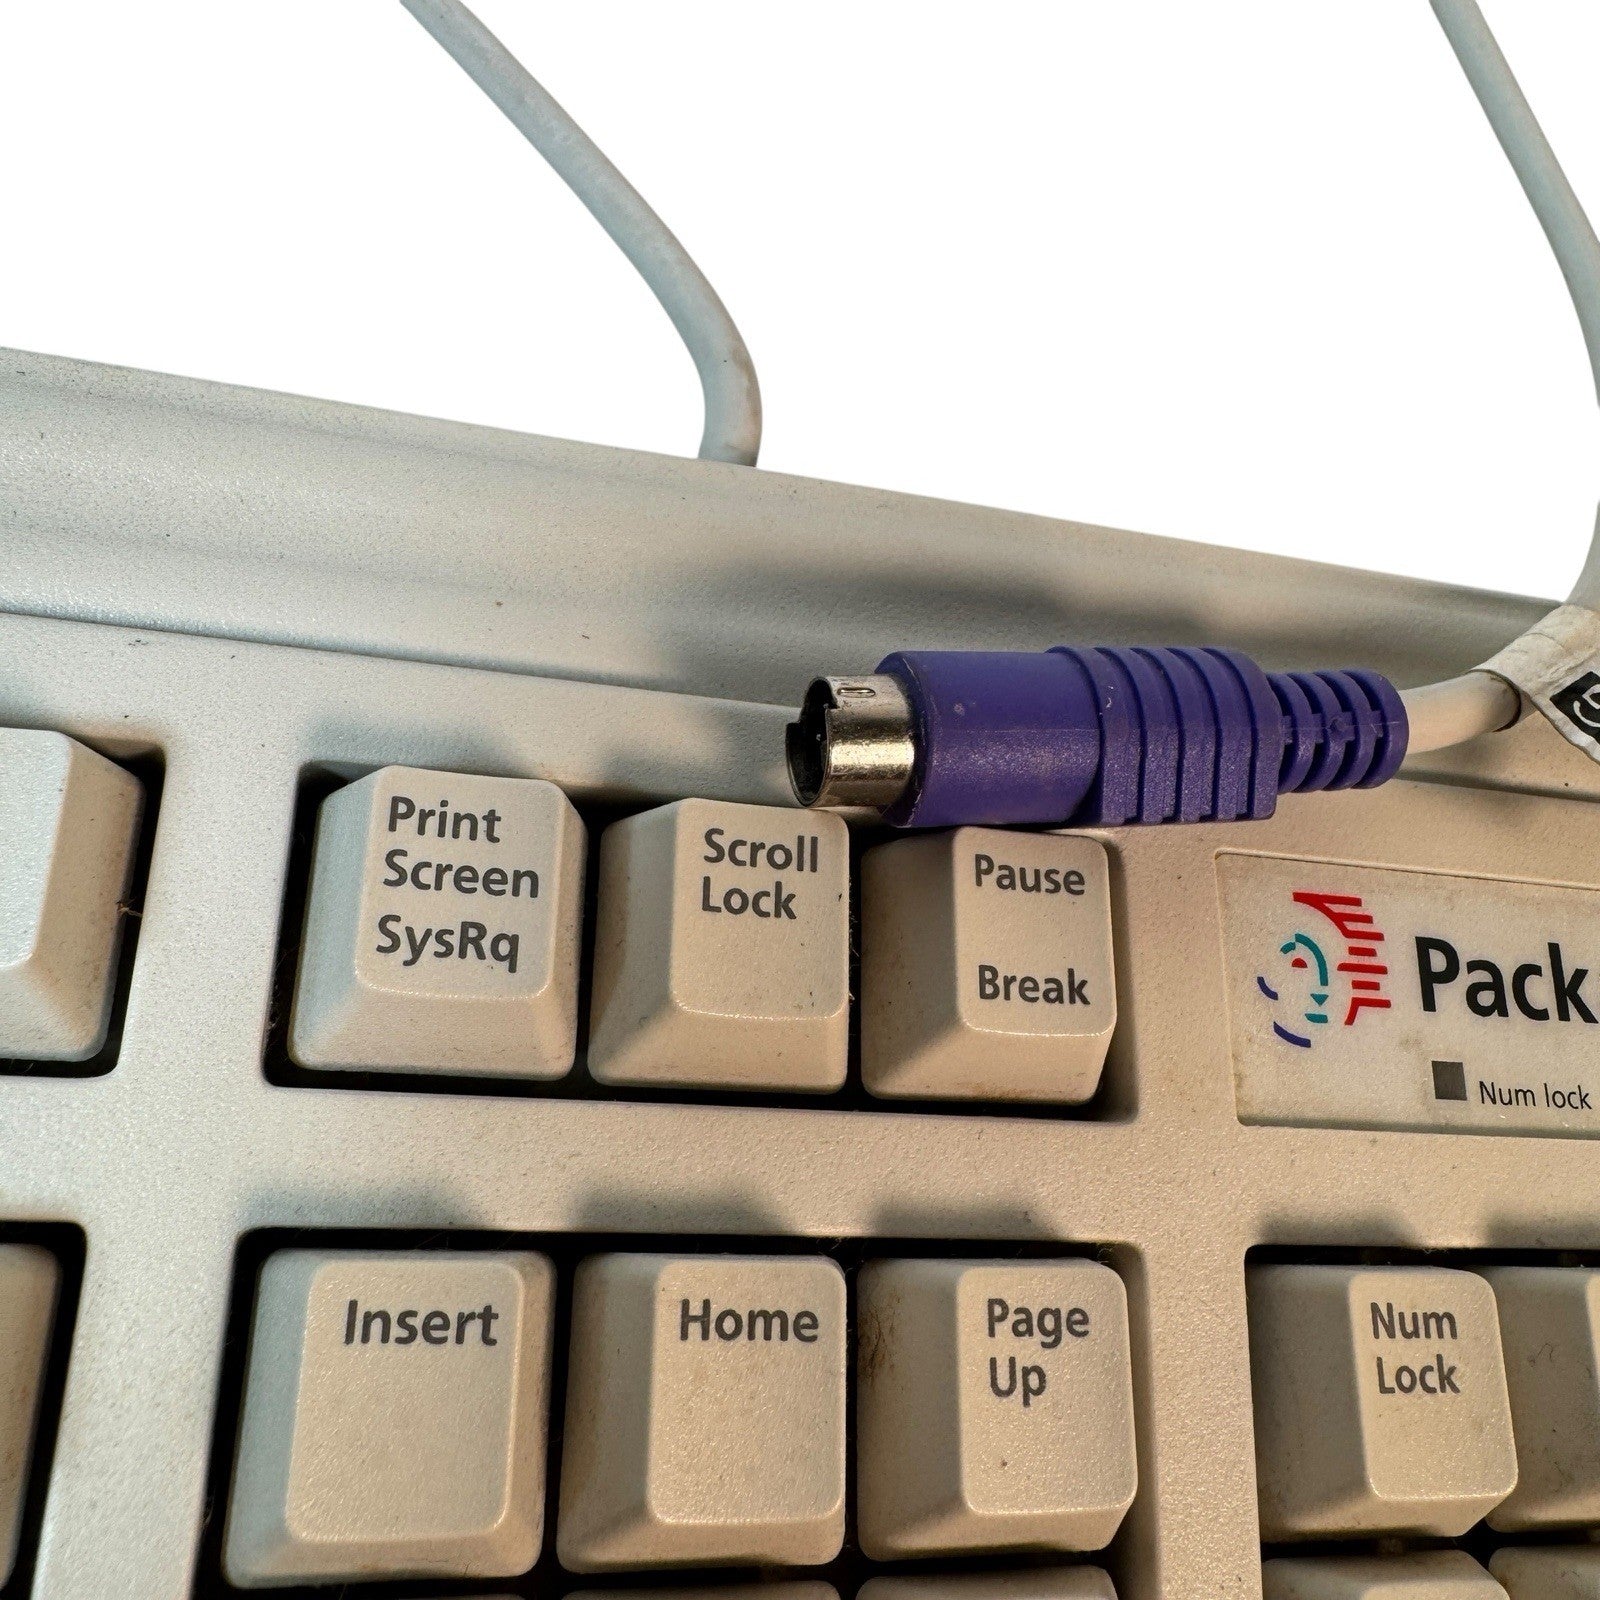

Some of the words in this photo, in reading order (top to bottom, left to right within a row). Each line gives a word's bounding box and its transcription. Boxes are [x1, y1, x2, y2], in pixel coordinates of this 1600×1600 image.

[388, 795, 502, 844] Print
[382, 847, 540, 899] Screen
[704, 827, 819, 874] Scroll
[701, 874, 797, 920] Lock
[975, 853, 1086, 896] Pause
[375, 914, 520, 974] SysRq
[978, 964, 1091, 1006] Break
[1414, 935, 1600, 1024] Pack
[1478, 1080, 1537, 1107] Num
[1543, 1082, 1593, 1110] lock
[343, 1298, 500, 1347] Insert
[680, 1298, 820, 1344] Home
[986, 1297, 1090, 1350] Page
[1370, 1301, 1458, 1341] Num
[989, 1356, 1047, 1409] Up
[1376, 1353, 1461, 1395] Lock
